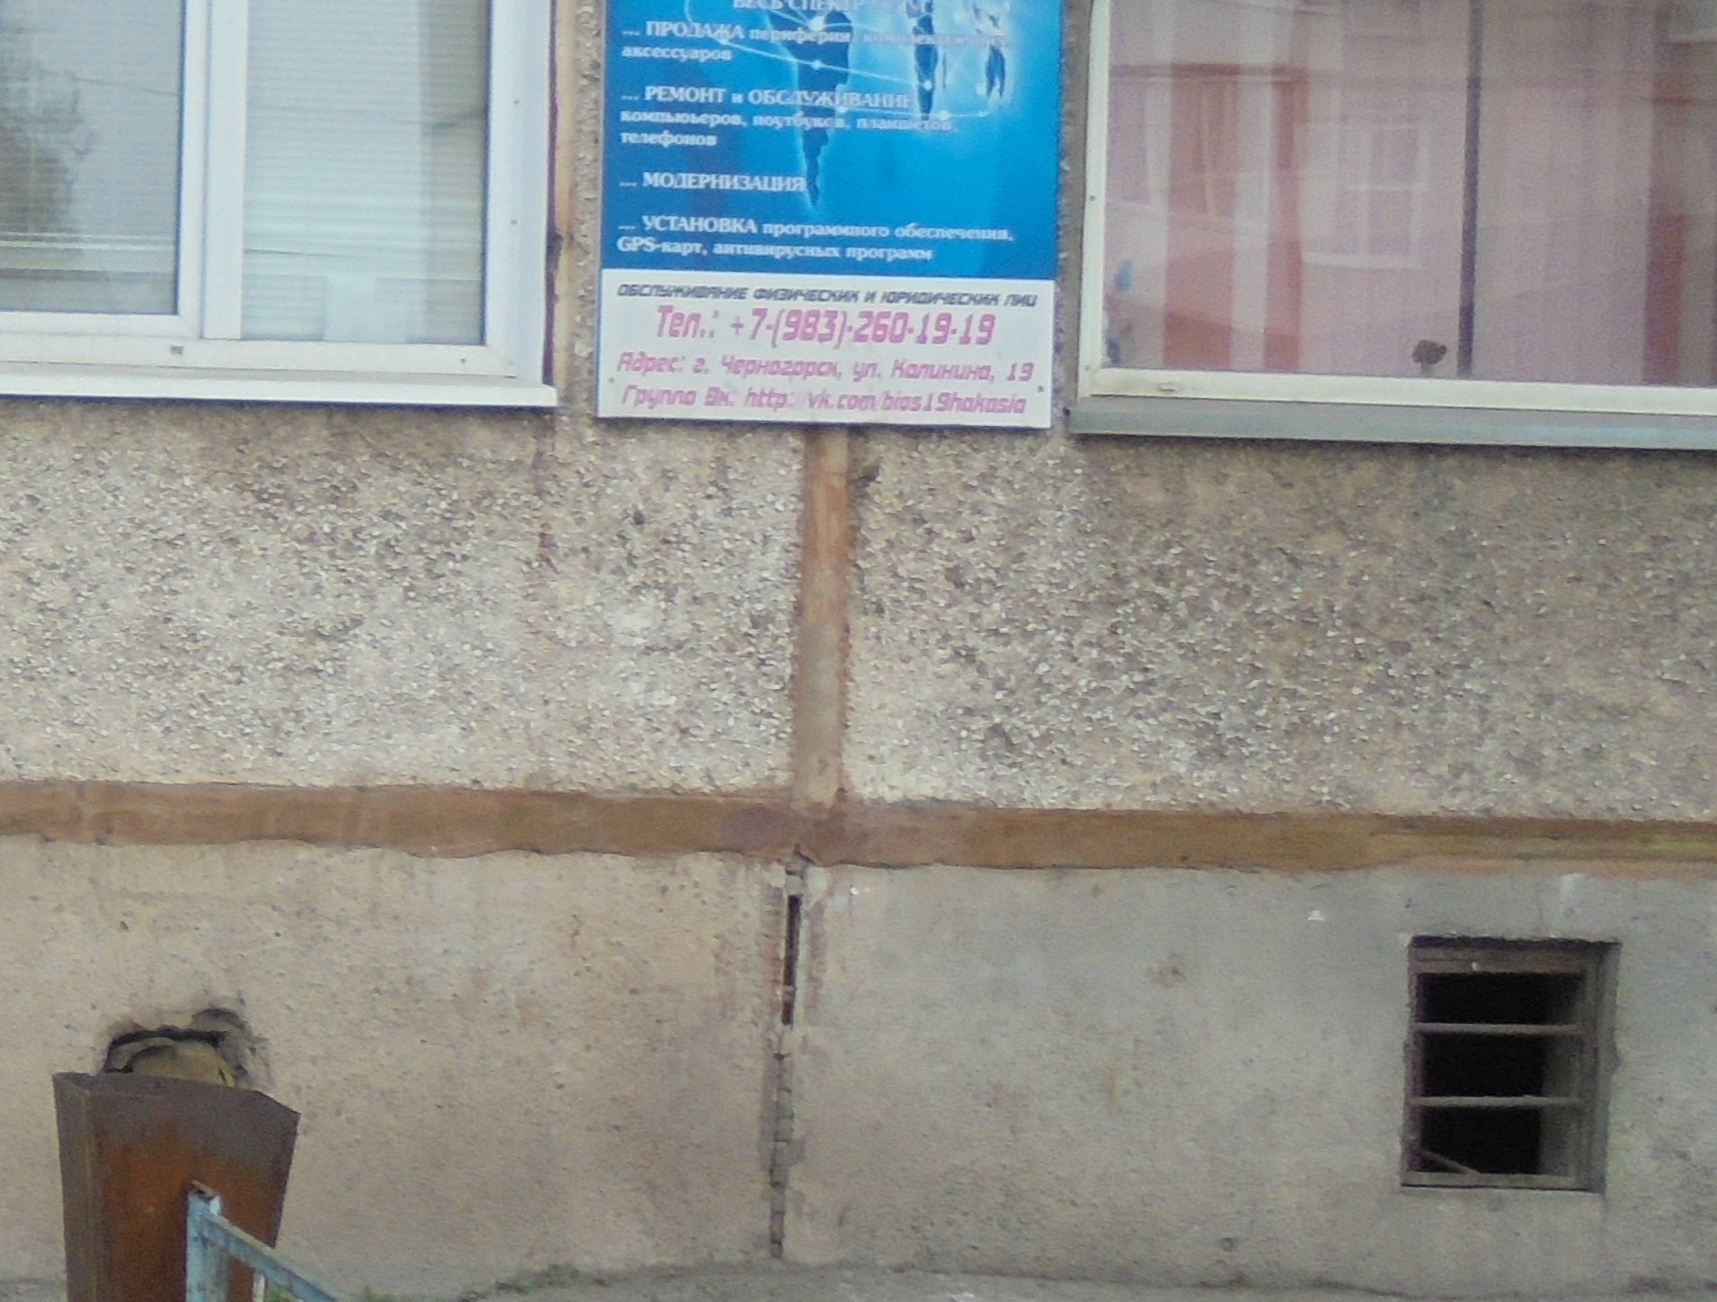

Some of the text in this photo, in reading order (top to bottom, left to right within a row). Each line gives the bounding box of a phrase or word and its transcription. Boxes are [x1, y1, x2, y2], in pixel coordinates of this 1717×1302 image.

[646, 21, 744, 39] ПРОДАЖА
[622, 46, 733, 63] аксессуаров
[645, 86, 727, 103] РЕМОНТ
[748, 89, 913, 108] ОБСЛУЖИВАНИЕ
[620, 130, 718, 148] телефонов
[642, 172, 807, 192] МОДЕРНИЗАЦИЯ
[642, 215, 758, 234] УСТАНОВКА
[762, 223, 890, 238] программного
[894, 223, 1013, 241] обеспечения,
[617, 236, 708, 256] GPS-карт,
[713, 243, 840, 259] антивирусных
[1004, 294, 1038, 307] ЛИЦ
[1006, 362, 1034, 381] 19
